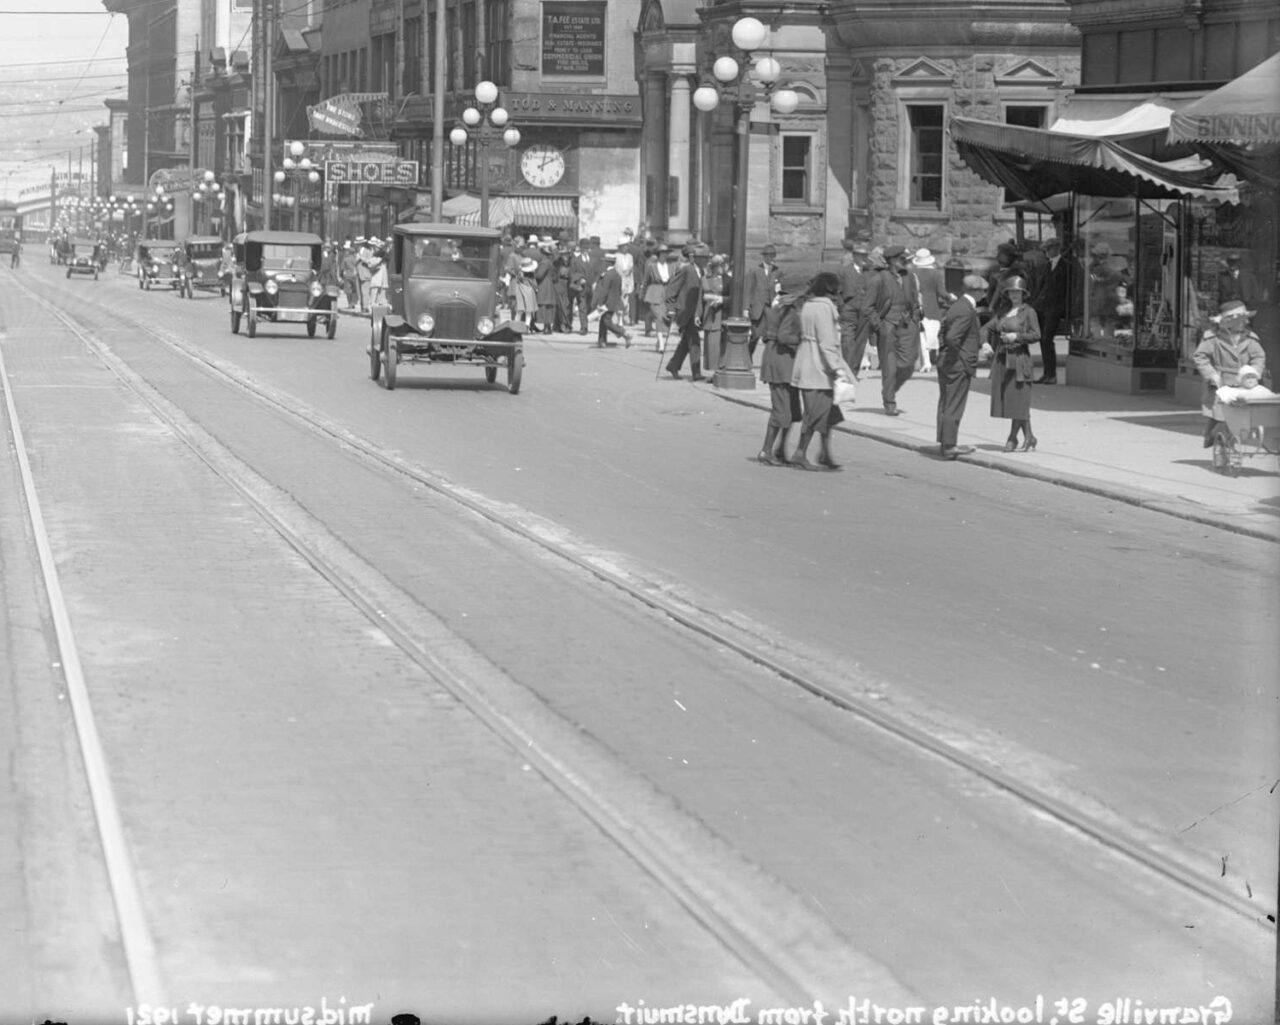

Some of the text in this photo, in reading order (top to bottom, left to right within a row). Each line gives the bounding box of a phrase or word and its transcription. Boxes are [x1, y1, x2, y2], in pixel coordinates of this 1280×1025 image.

[511, 98, 541, 112] TOD
[562, 98, 633, 114] MANNING
[330, 163, 414, 181] SHOES
